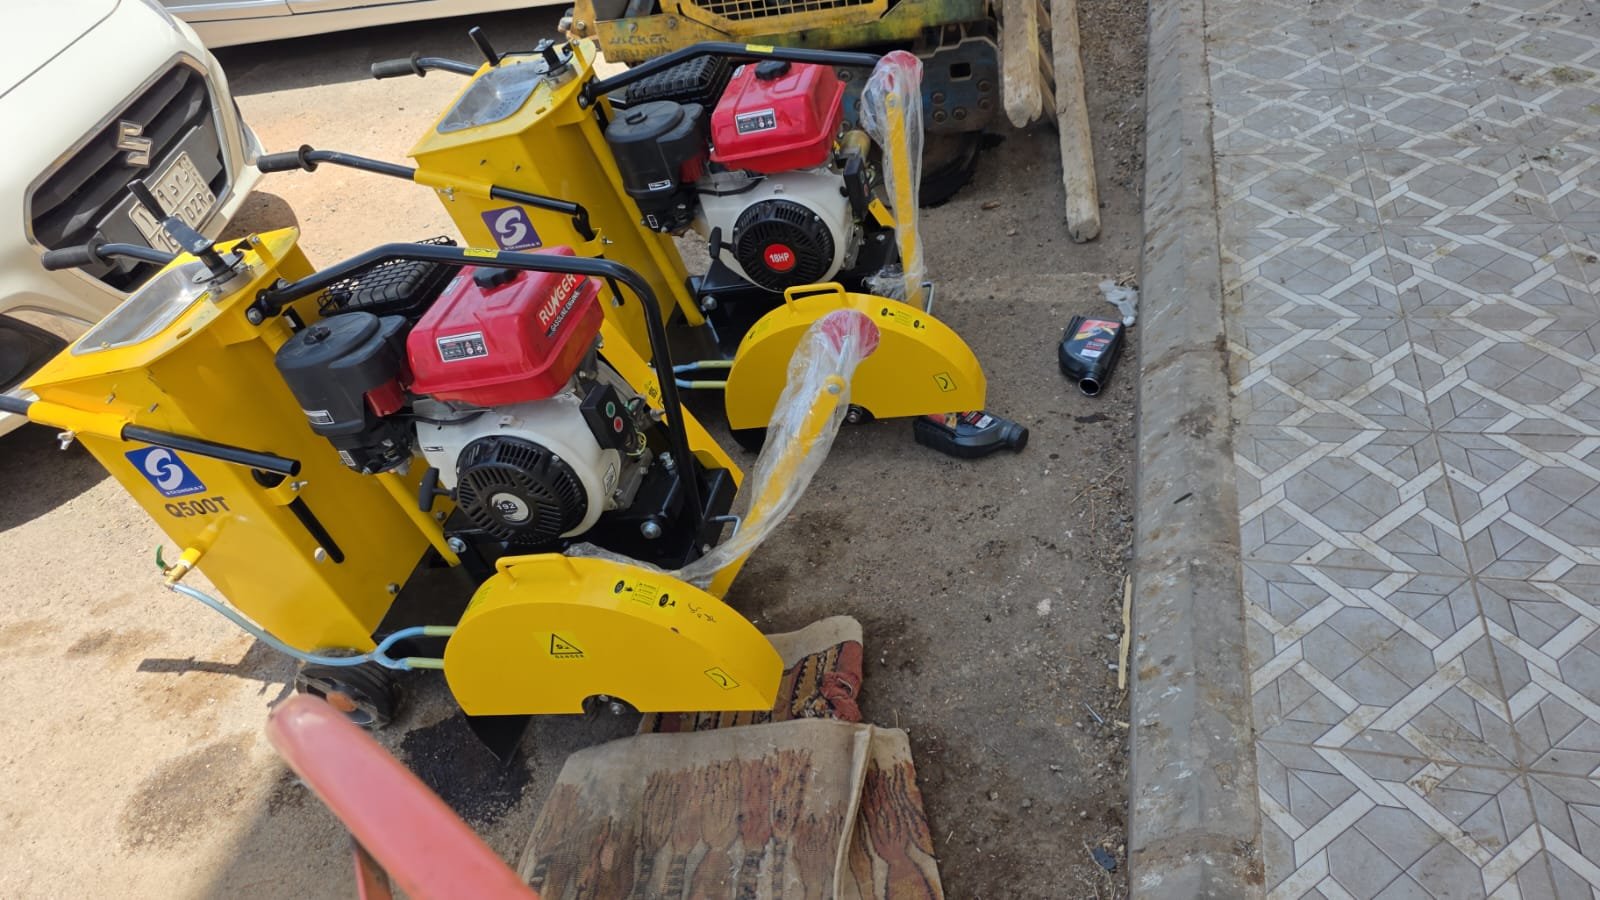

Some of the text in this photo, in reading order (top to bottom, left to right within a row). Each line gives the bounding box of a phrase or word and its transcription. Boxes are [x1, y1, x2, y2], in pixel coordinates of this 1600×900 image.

[769, 252, 789, 263] 18HP
[538, 273, 577, 326] RUNGER
[165, 496, 229, 518] Q500T
